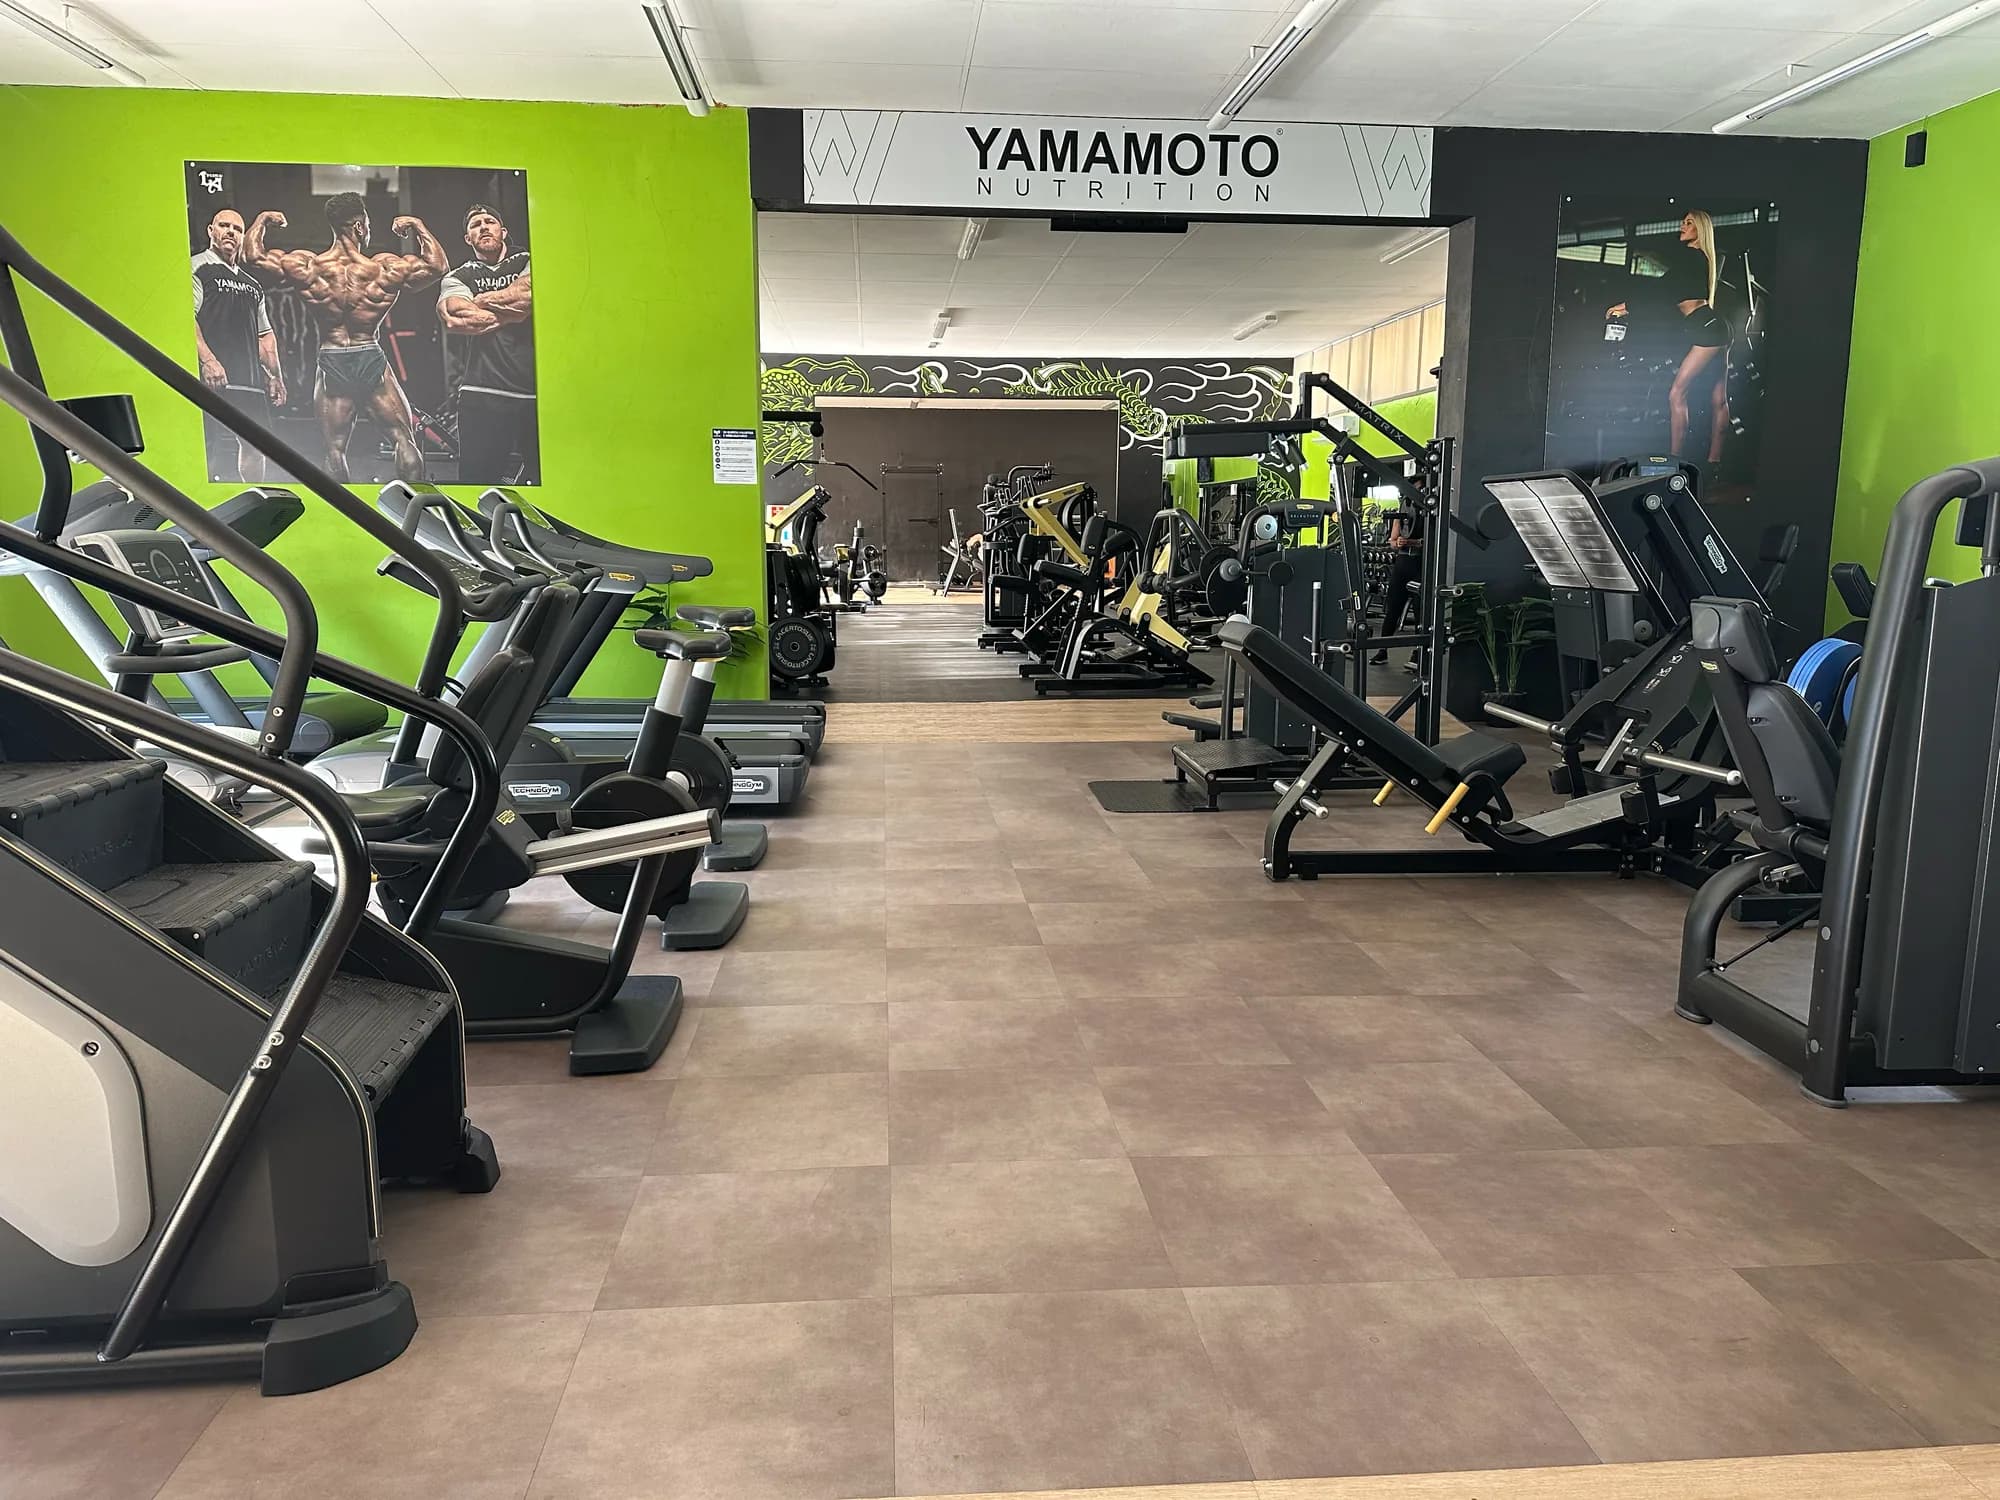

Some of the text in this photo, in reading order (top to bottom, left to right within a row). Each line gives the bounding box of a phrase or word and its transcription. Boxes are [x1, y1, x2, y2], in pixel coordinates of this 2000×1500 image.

[964, 126, 1280, 178] YAMAMOTO
[977, 176, 1270, 203] NUTRITION
[1354, 401, 1404, 441] MATRIX
